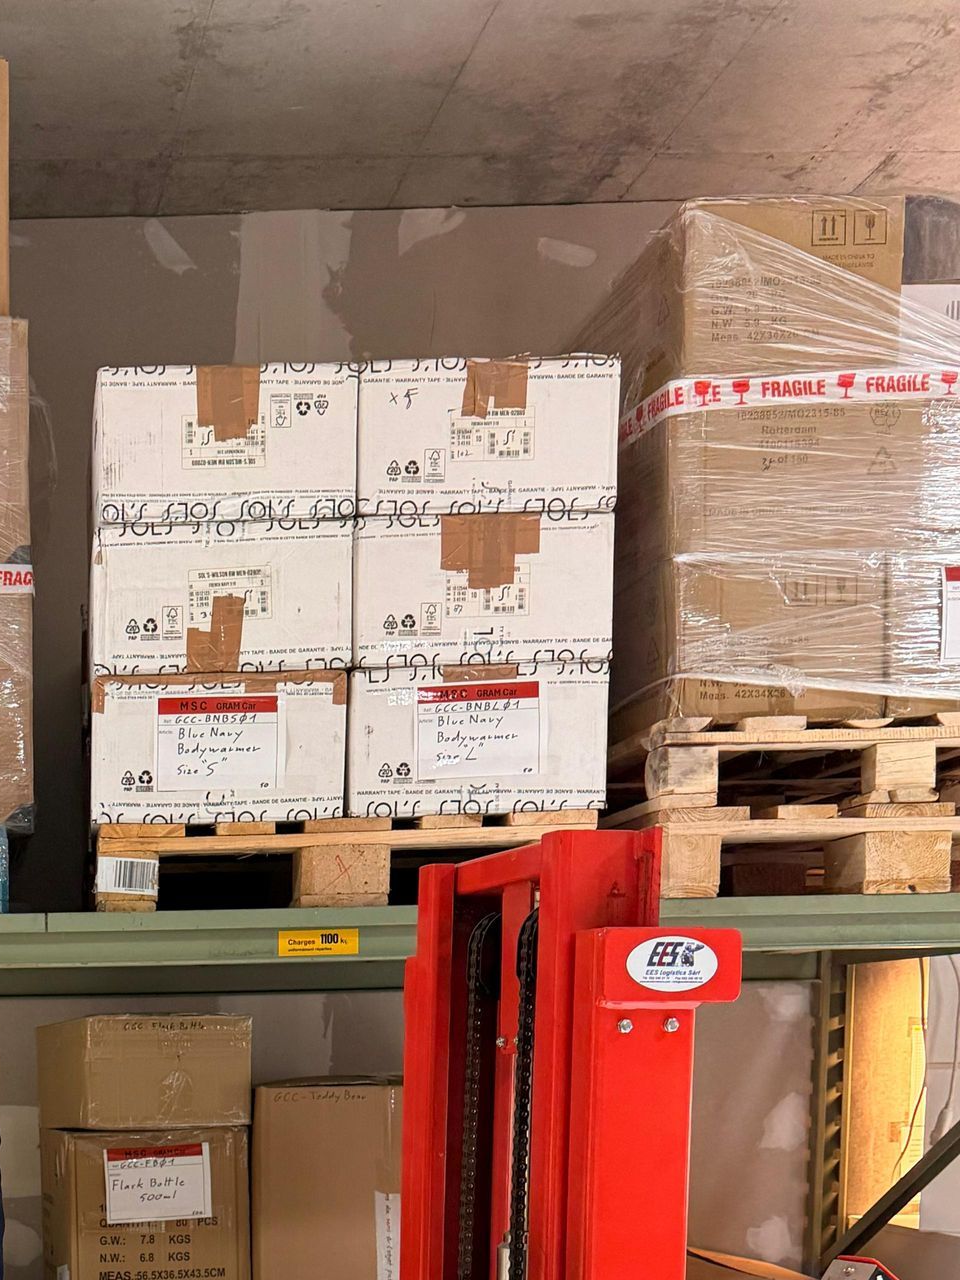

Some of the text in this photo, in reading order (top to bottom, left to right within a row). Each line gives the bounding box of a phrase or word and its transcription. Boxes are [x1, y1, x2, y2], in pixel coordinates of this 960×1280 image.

[761, 374, 930, 398] FRAGILE FRAGILE
[647, 386, 685, 422] FRAGILE
[477, 688, 502, 698] GRAM
[502, 688, 518, 697] Car
[180, 702, 256, 711] MSC GRAM Car
[437, 714, 464, 726] Blue
[469, 714, 504, 728] Navy
[178, 727, 205, 740] Blue
[210, 728, 244, 744] Navy
[437, 731, 519, 747] Bodywarmer
[177, 742, 261, 759] Bodywarmer
[288, 938, 316, 946] Charges
[320, 934, 338, 944] 1100
[647, 942, 685, 967] EES
[150, 1177, 185, 1188] Bottle
[176, 1216, 218, 1227] 80 PCS
[100, 1234, 191, 1246] G.W.: 7.8 KGS
[100, 1252, 190, 1264] N.W.: 6.8 KGS
